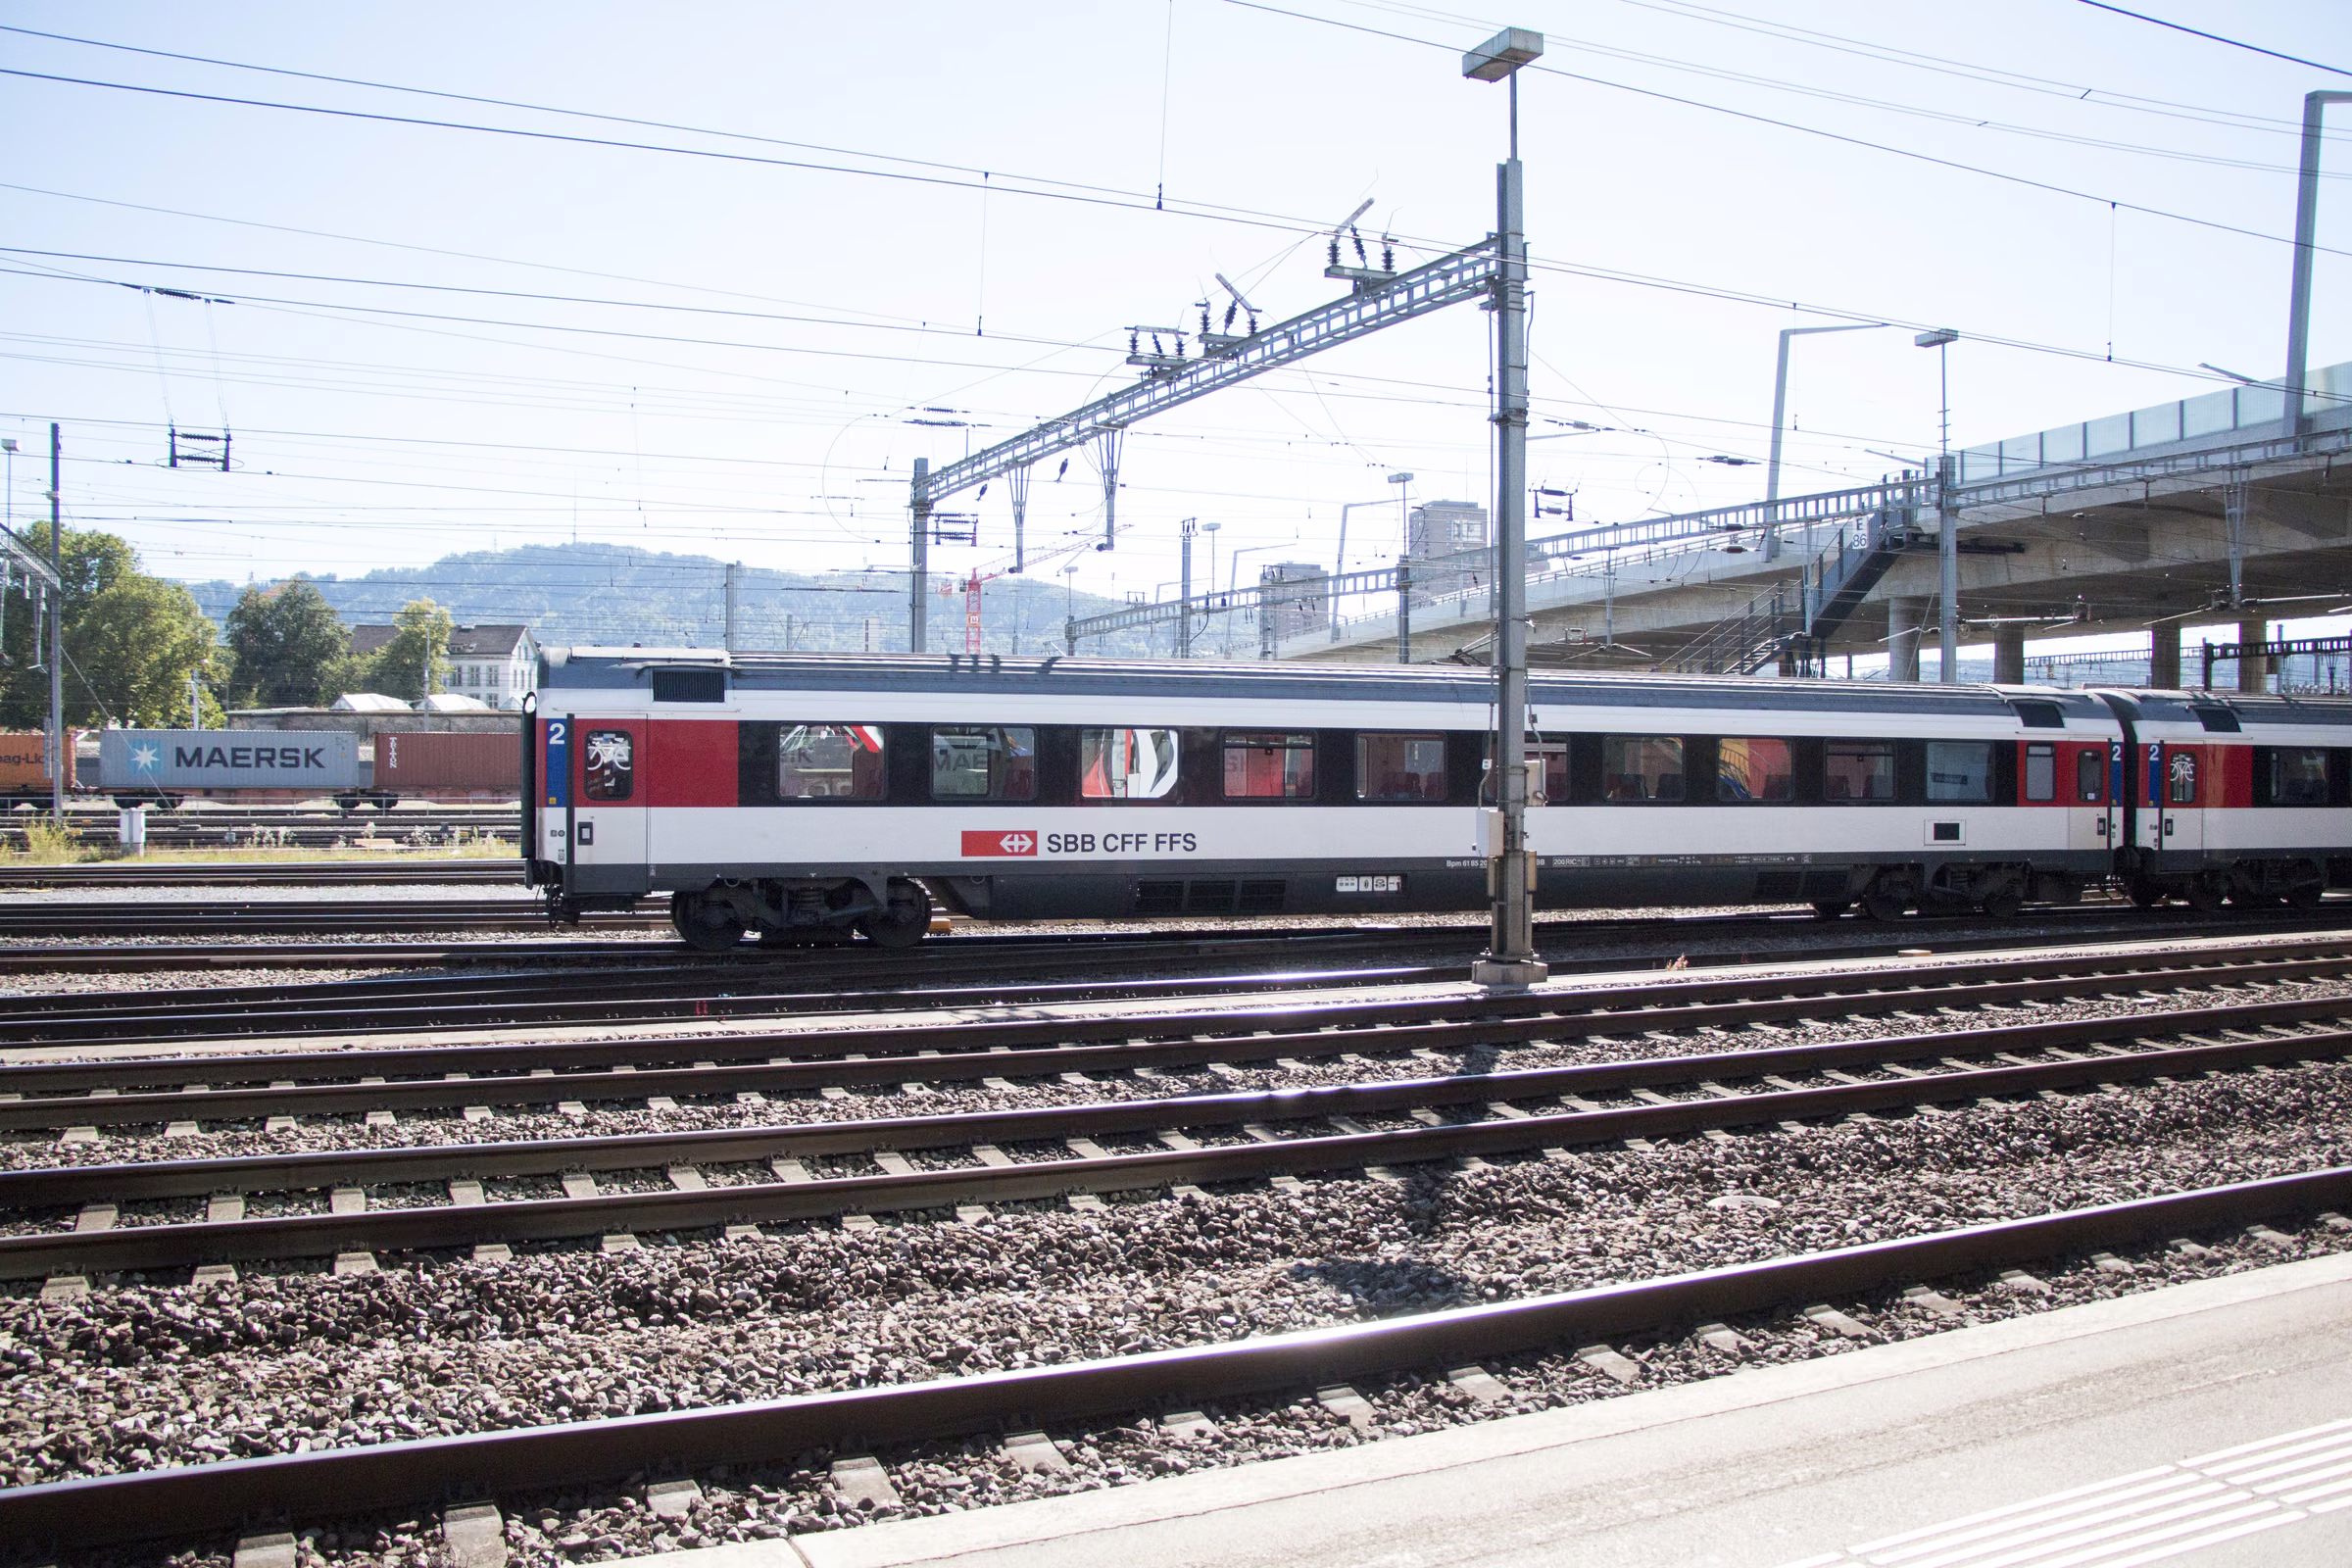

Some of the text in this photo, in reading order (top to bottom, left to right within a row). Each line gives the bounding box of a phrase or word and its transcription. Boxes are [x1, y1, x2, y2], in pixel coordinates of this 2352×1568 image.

[1856, 518, 1864, 530] E
[1852, 533, 1867, 548] 86
[549, 722, 565, 745] 2
[175, 746, 326, 769] MAERSK
[2112, 745, 2122, 761] 2
[2149, 745, 2159, 761] 2
[1047, 832, 1197, 854] SBB CFF FFS
[1446, 859, 1461, 868] Bpm
